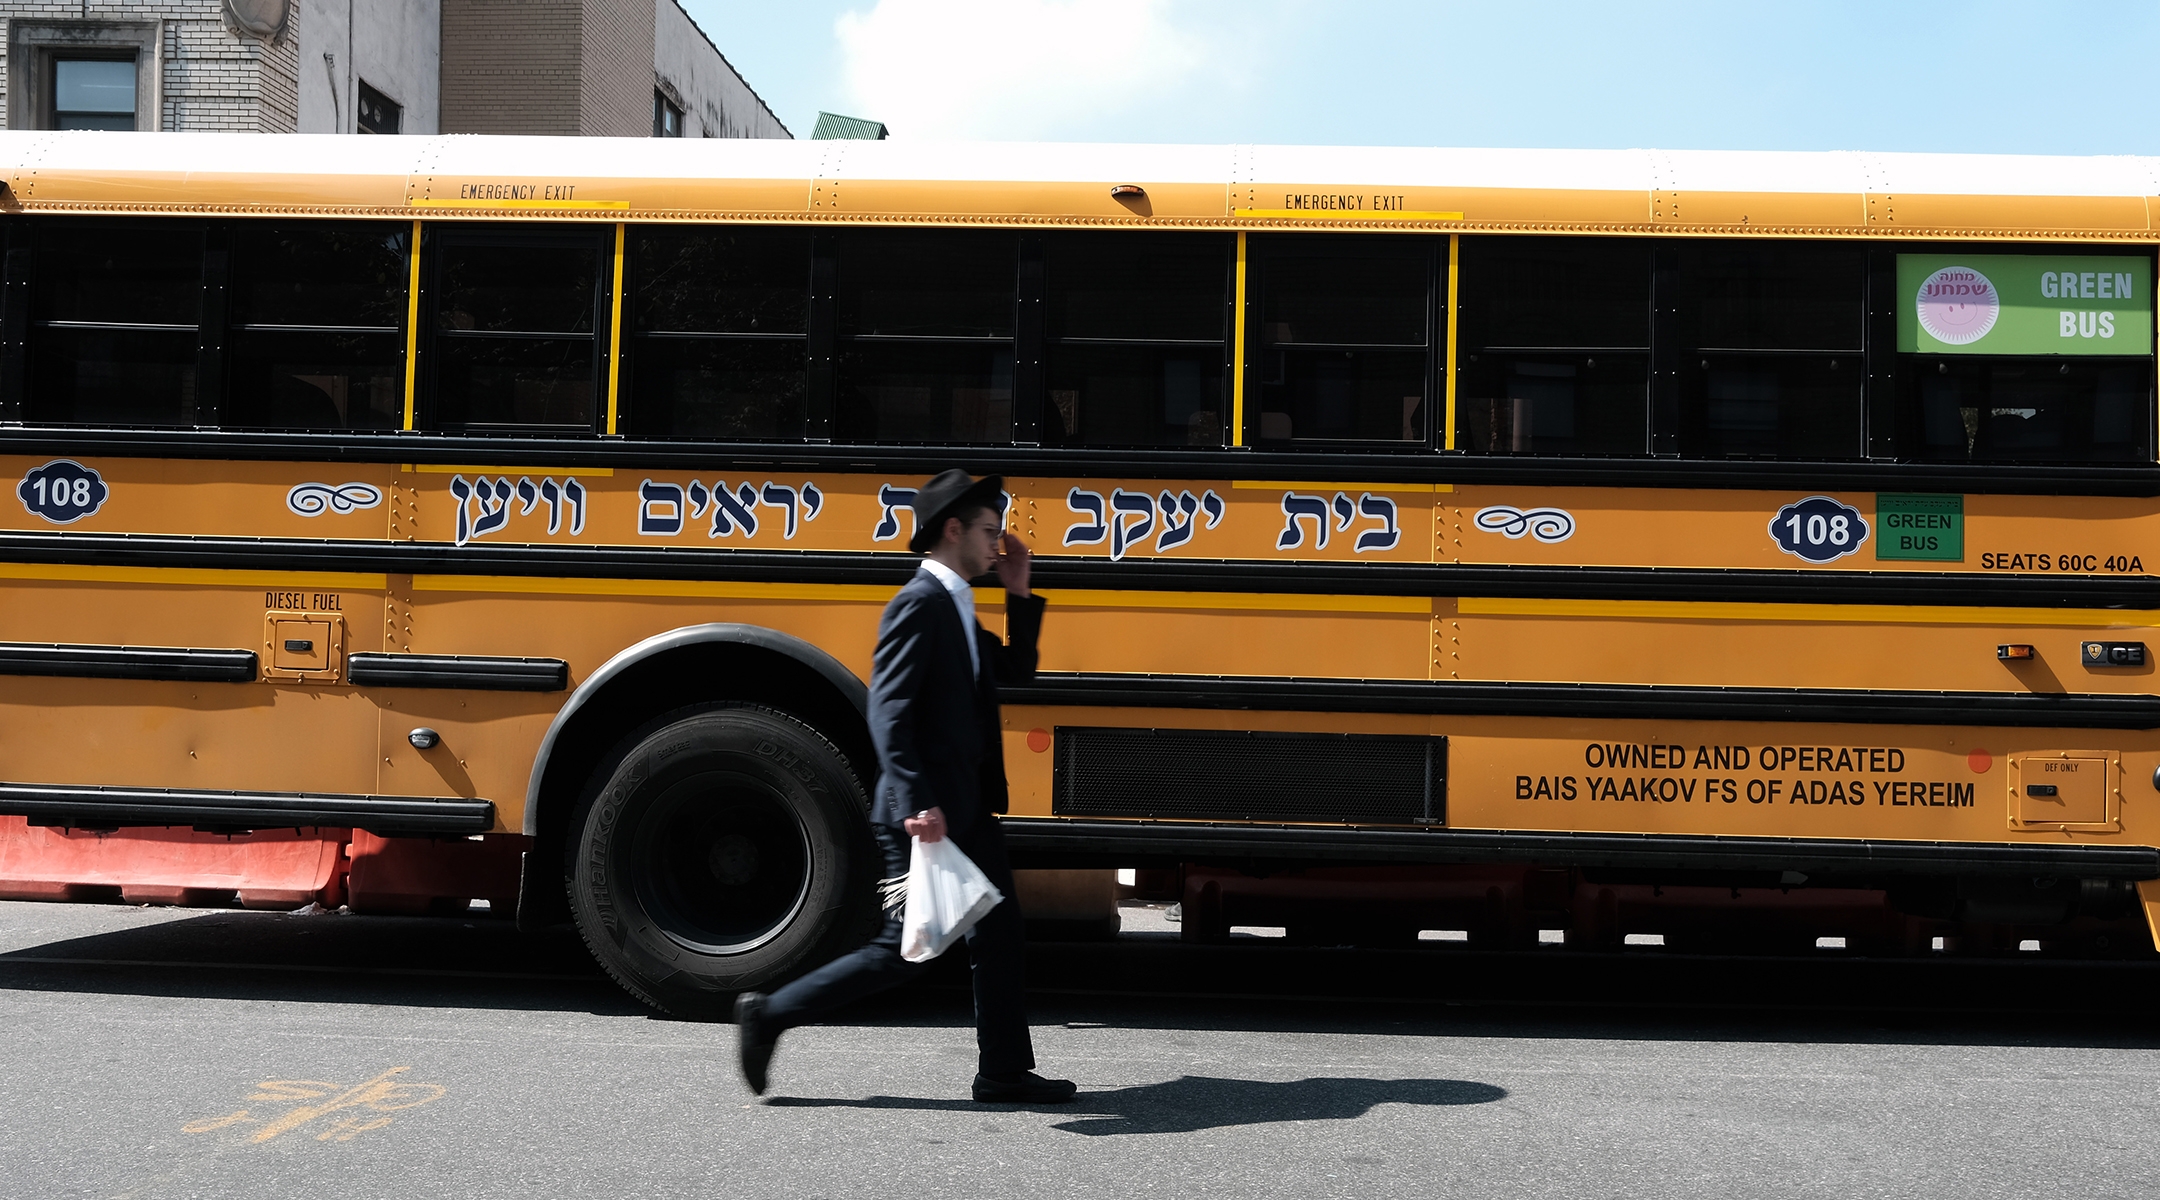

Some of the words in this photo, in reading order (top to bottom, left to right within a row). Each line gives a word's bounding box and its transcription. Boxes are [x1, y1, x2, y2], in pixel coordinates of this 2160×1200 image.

[461, 184, 536, 200] EMERGENCY
[545, 185, 575, 200] EXIT
[1285, 194, 1363, 210] EMERGENCY
[1373, 195, 1404, 211] EXIT
[1940, 272, 1975, 282] מחנה
[2041, 271, 2132, 299] GREEN
[1927, 284, 1988, 297] שמחנו
[2060, 311, 2115, 338] BUS
[33, 477, 91, 507] 108
[450, 474, 586, 547] וויען
[638, 478, 823, 540] יראים
[1062, 486, 1225, 561] יעקב
[1276, 489, 1401, 553] בית
[1786, 514, 1850, 546] 108
[1887, 513, 1951, 529] GREEN
[1900, 536, 1938, 551] BUS
[1981, 552, 2051, 570] SEATS
[2058, 554, 2097, 571] 60C
[2104, 555, 2144, 572] 40A
[265, 592, 307, 610] DIESEL
[313, 594, 342, 611] FUEL
[2112, 647, 2142, 661] CE
[1584, 743, 1686, 770] OWNED
[1694, 745, 1750, 771] AND
[1759, 746, 1905, 773] OPERATED
[2045, 763, 2058, 772] DEF
[2060, 763, 2079, 773] ONLY
[1515, 775, 1578, 801] BAIS
[1586, 777, 1697, 803] YAAKOV
[1705, 779, 1738, 804] FS
[1747, 779, 1782, 804] OF
[1790, 780, 1866, 806] ADAS
[1874, 781, 1975, 808] YEREIM
